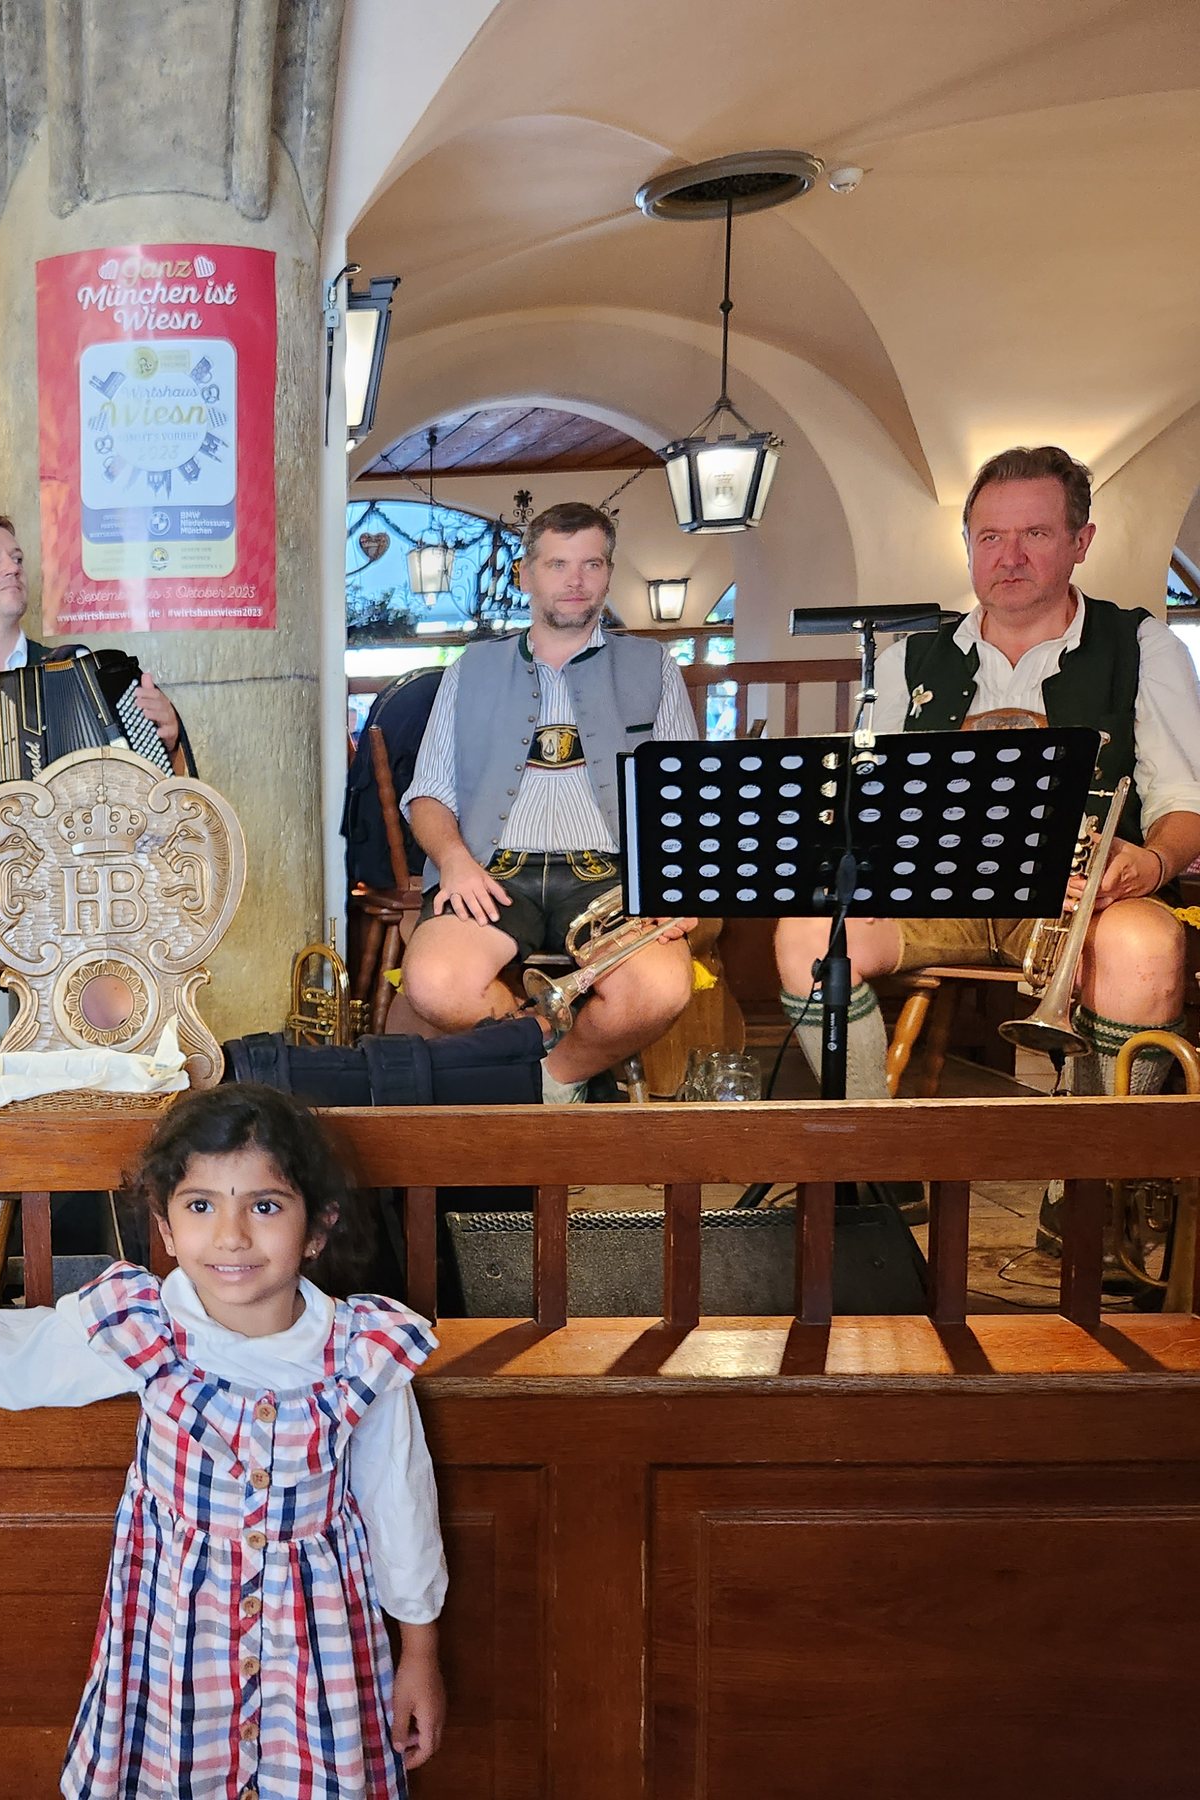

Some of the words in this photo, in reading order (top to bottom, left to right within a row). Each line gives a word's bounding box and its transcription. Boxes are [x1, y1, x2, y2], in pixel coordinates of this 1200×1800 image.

[77, 281, 201, 311] München
[204, 278, 238, 304] ist
[114, 306, 202, 331] Wiesn
[100, 401, 207, 427] Wiesn
[180, 511, 201, 519] BMW
[180, 527, 213, 535] München
[227, 584, 257, 598] 2023
[60, 864, 148, 935] HB
